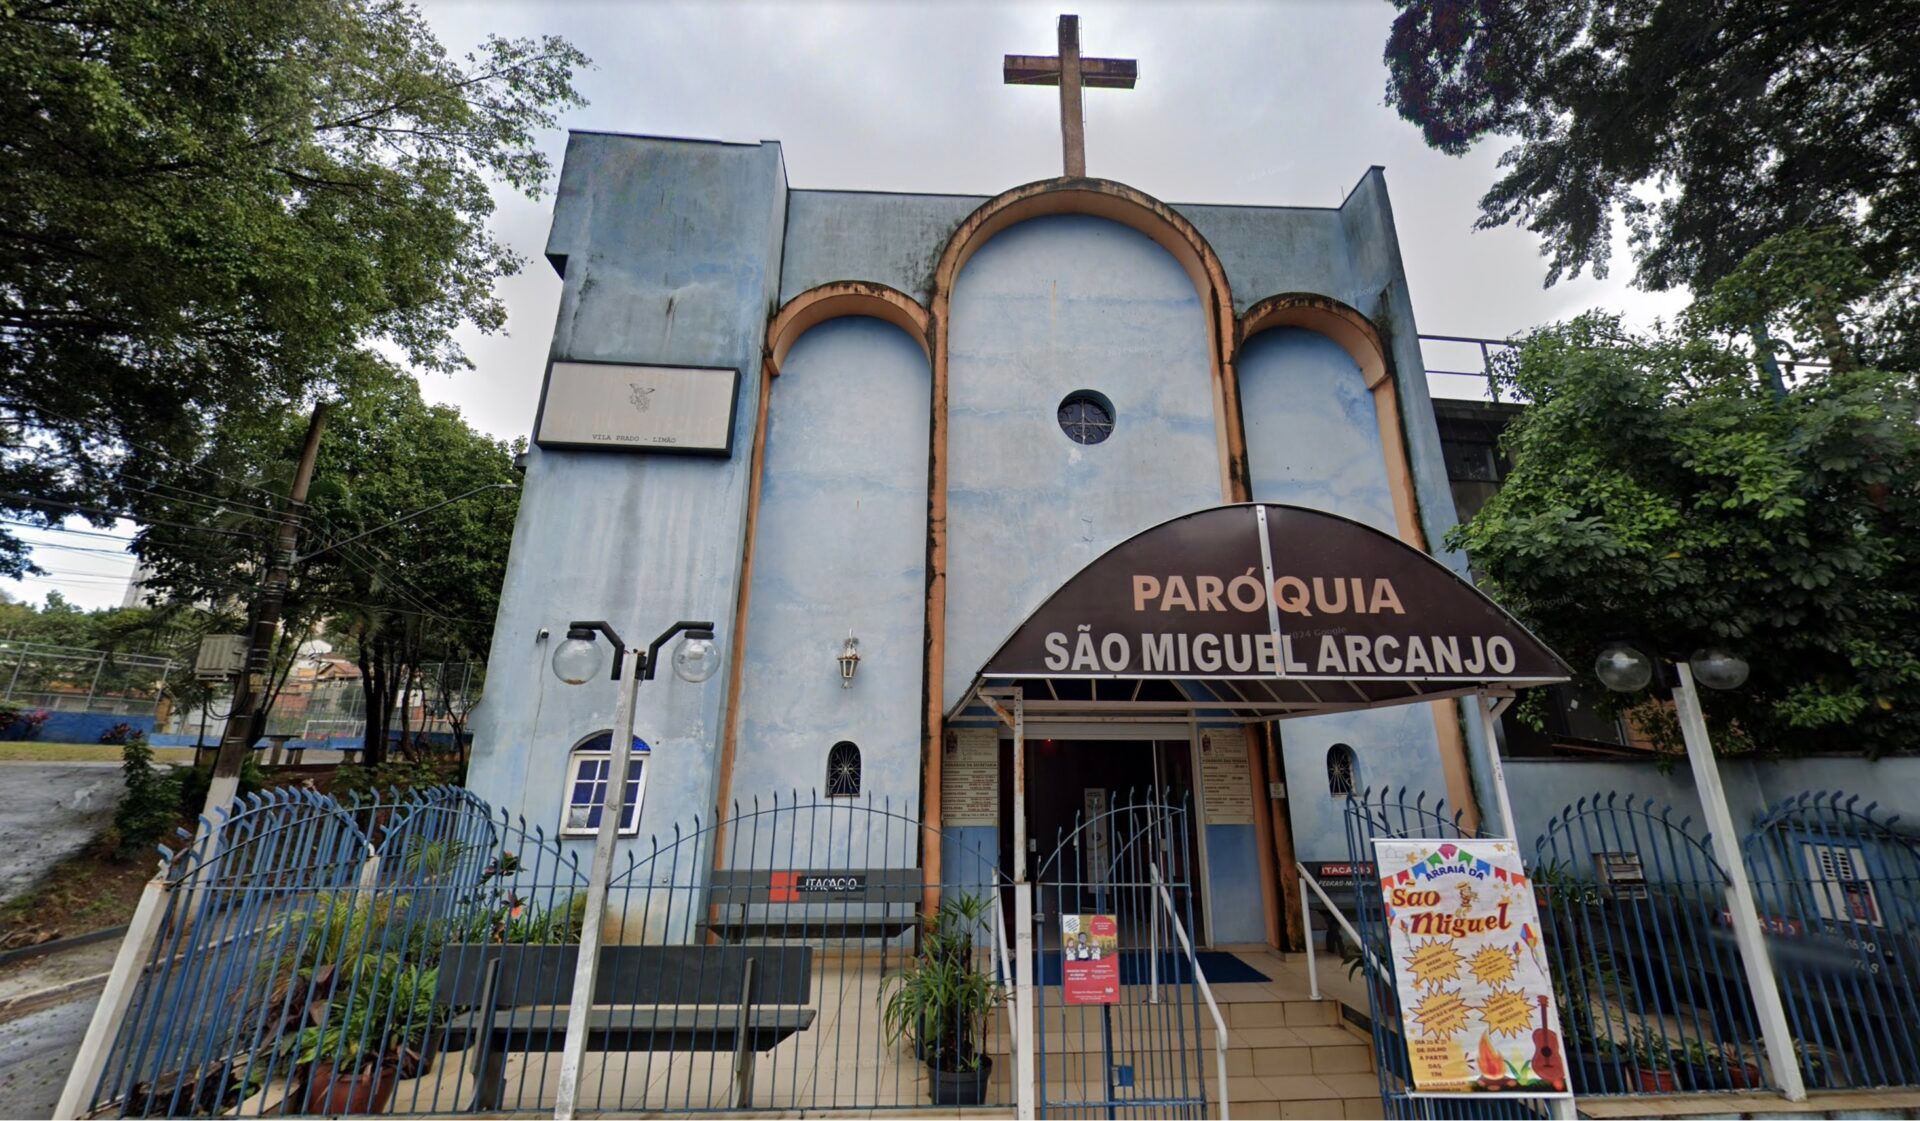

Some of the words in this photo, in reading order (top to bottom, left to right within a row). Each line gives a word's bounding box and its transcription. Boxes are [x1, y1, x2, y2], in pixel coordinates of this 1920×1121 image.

[592, 433, 611, 441] VILA
[616, 434, 639, 442] PRADO
[1132, 567, 1405, 617] PARÓQUIA
[1044, 624, 1131, 671] SÃO
[1142, 632, 1307, 674] MIGUEL
[1317, 634, 1516, 674] ARCANJO
[805, 878, 857, 892] ITAÇACO
[1425, 862, 1466, 881] ARRAIÁ
[1469, 867, 1485, 880] DA
[1391, 880, 1441, 907] São
[1411, 902, 1513, 938] Miguel
